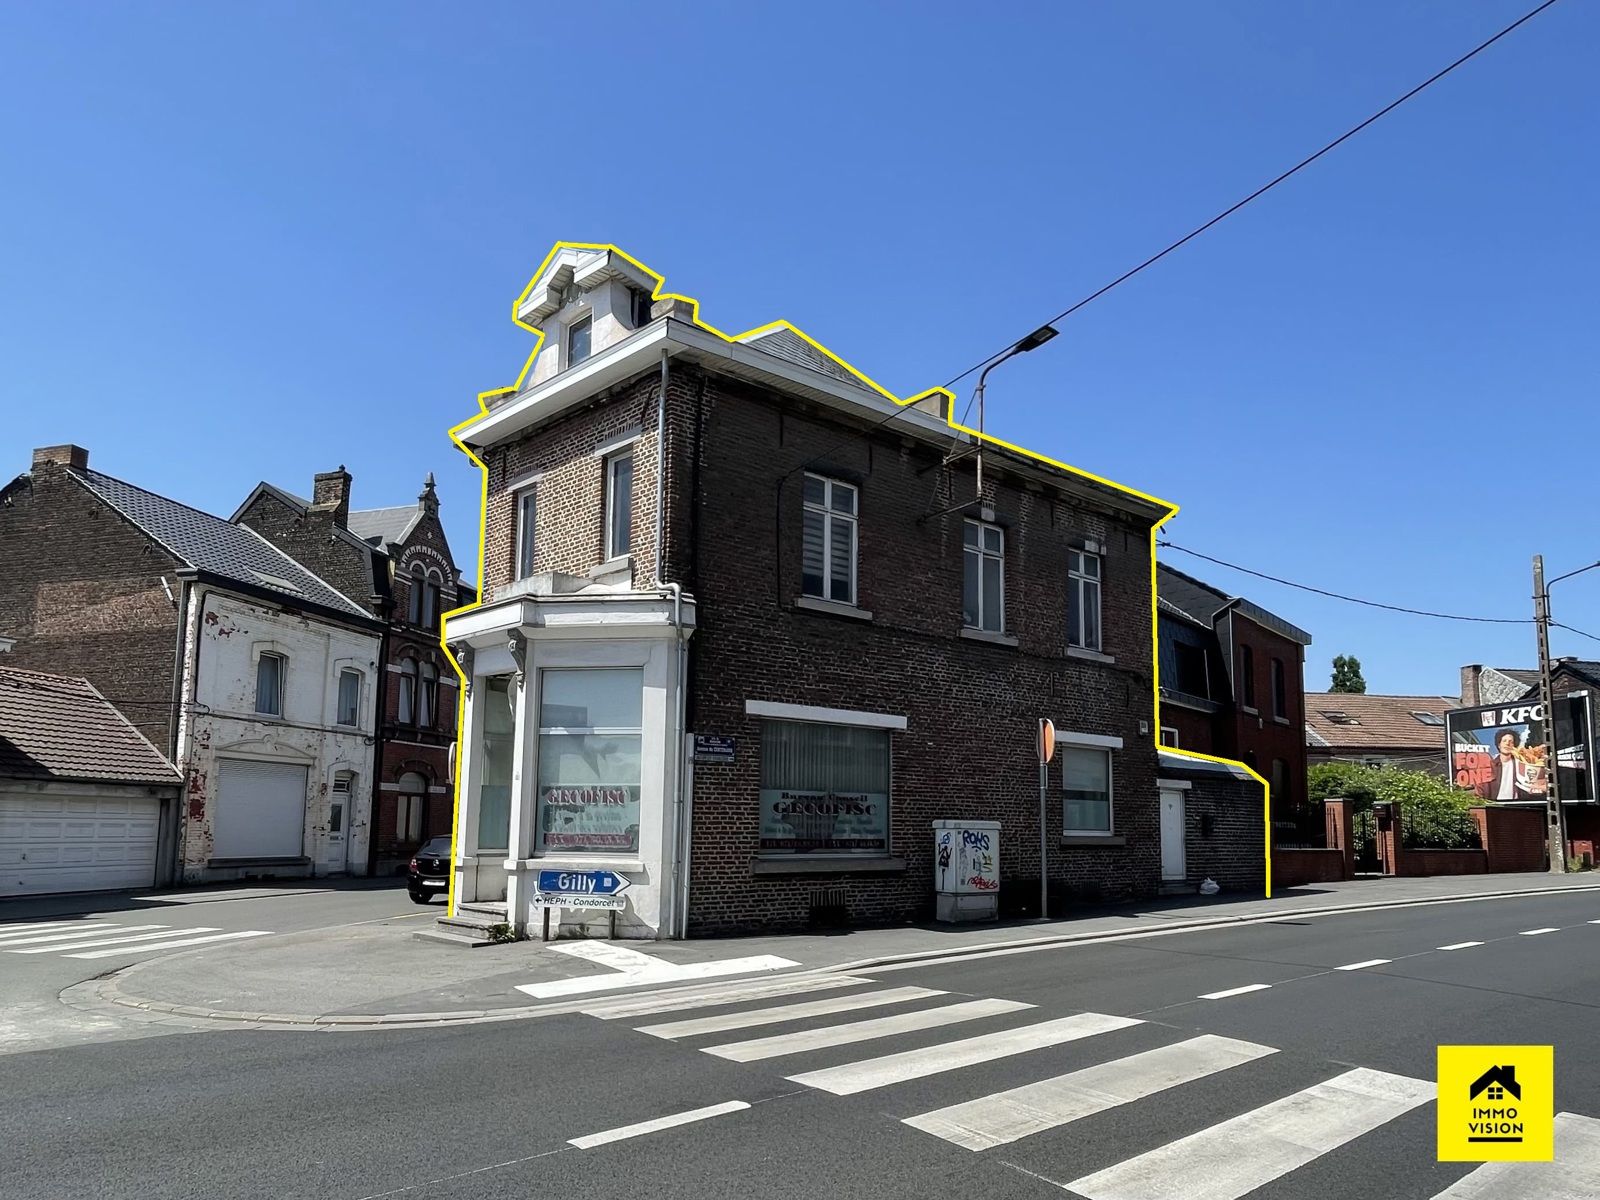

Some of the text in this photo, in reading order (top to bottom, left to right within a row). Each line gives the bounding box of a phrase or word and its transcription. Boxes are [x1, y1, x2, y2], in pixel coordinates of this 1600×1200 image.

[1500, 705, 1543, 725] KFC
[1454, 743, 1491, 753] BUCKET
[1456, 752, 1493, 769] FOR
[1456, 767, 1495, 787] ONE
[558, 873, 597, 895] Gilly
[543, 897, 567, 906] HEPH
[573, 898, 616, 907] Condorcet
